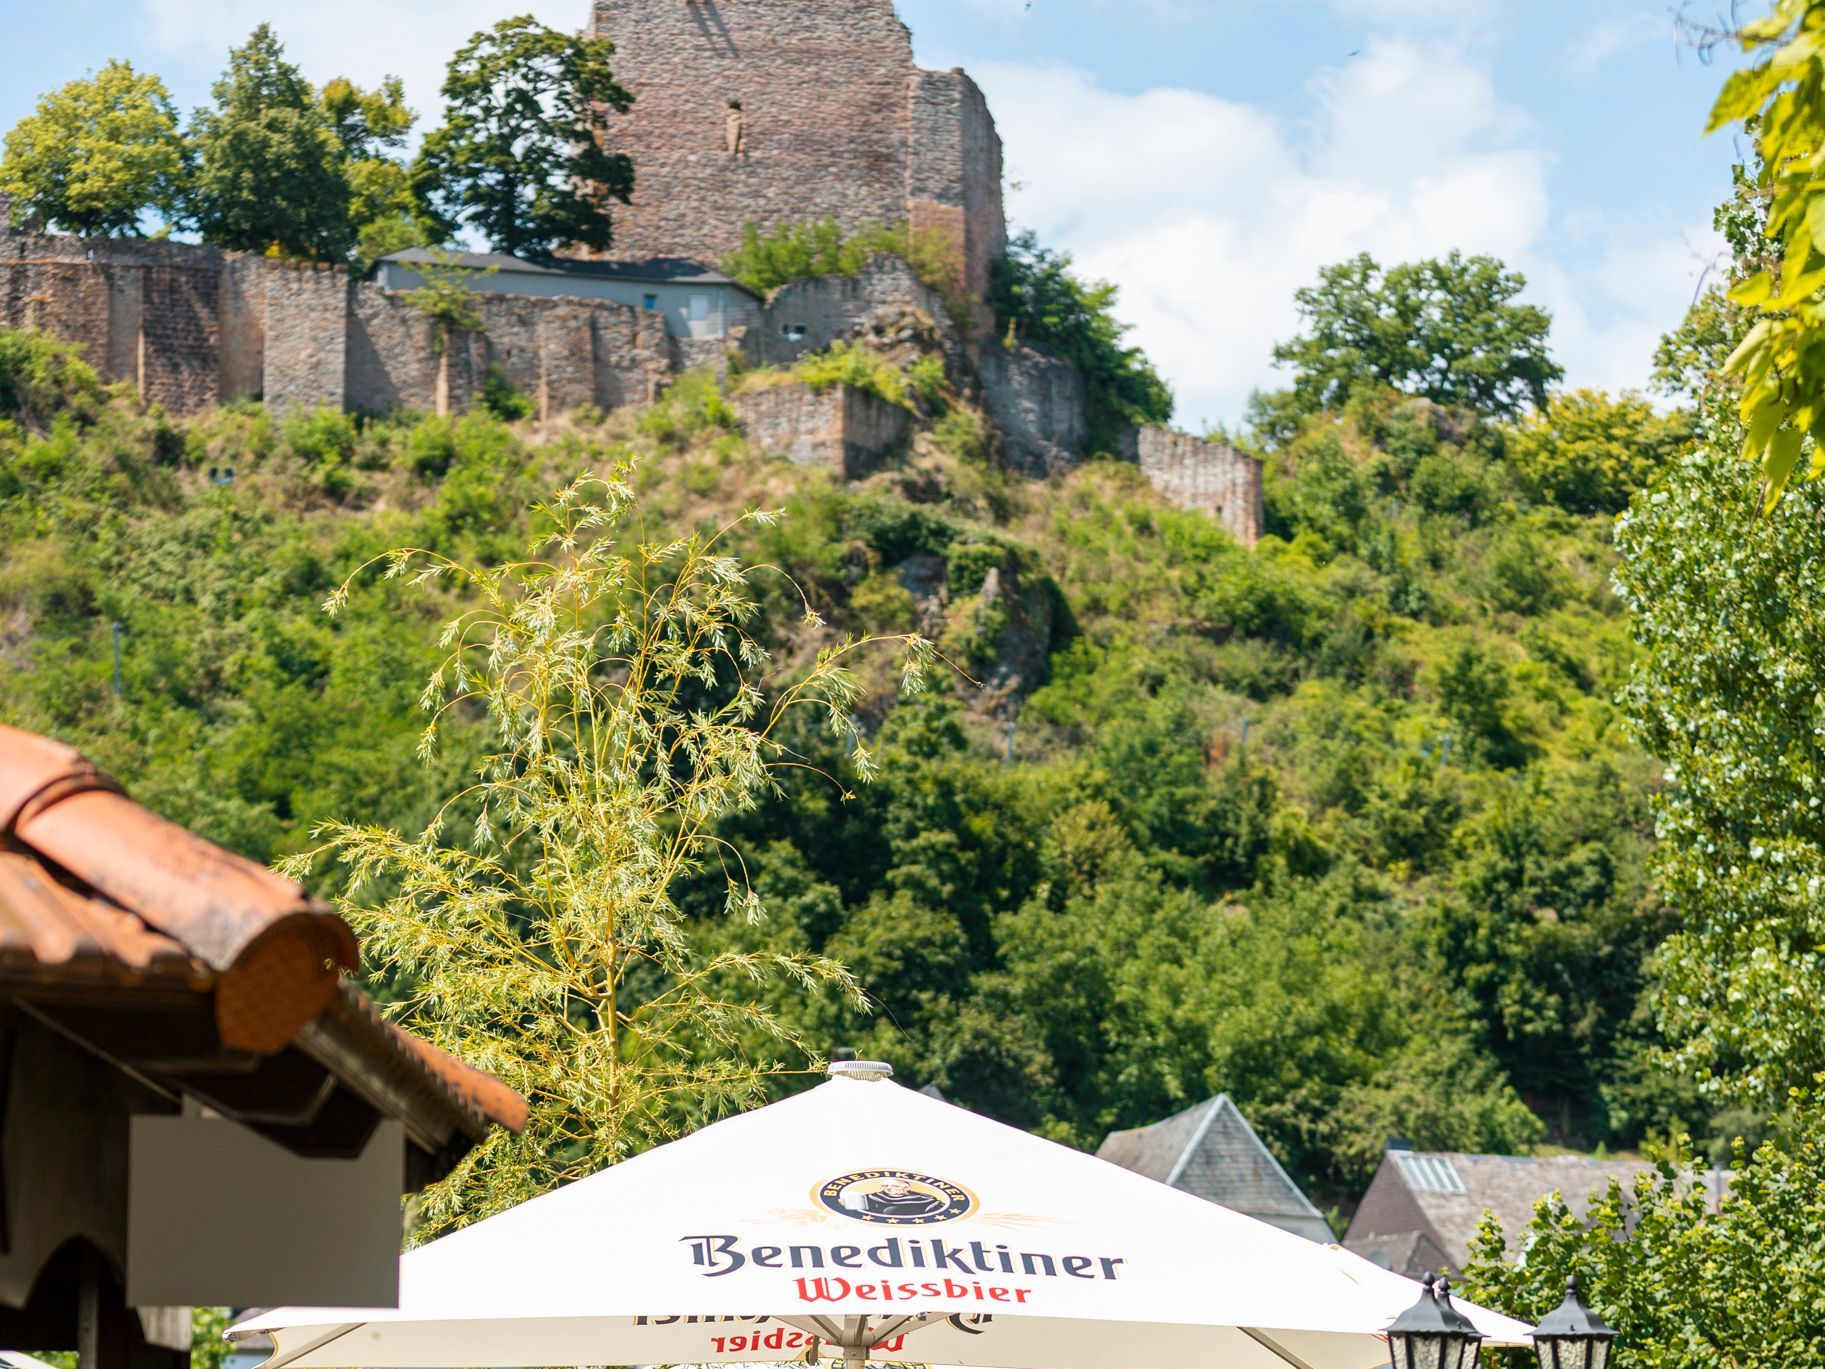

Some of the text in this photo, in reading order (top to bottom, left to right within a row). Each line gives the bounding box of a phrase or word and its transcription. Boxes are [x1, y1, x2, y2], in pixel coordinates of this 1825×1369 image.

[823, 1171, 965, 1201] BENEDIKTINER
[679, 1235, 1124, 1279] Benediktiner
[794, 1277, 1031, 1303] Weissbier
